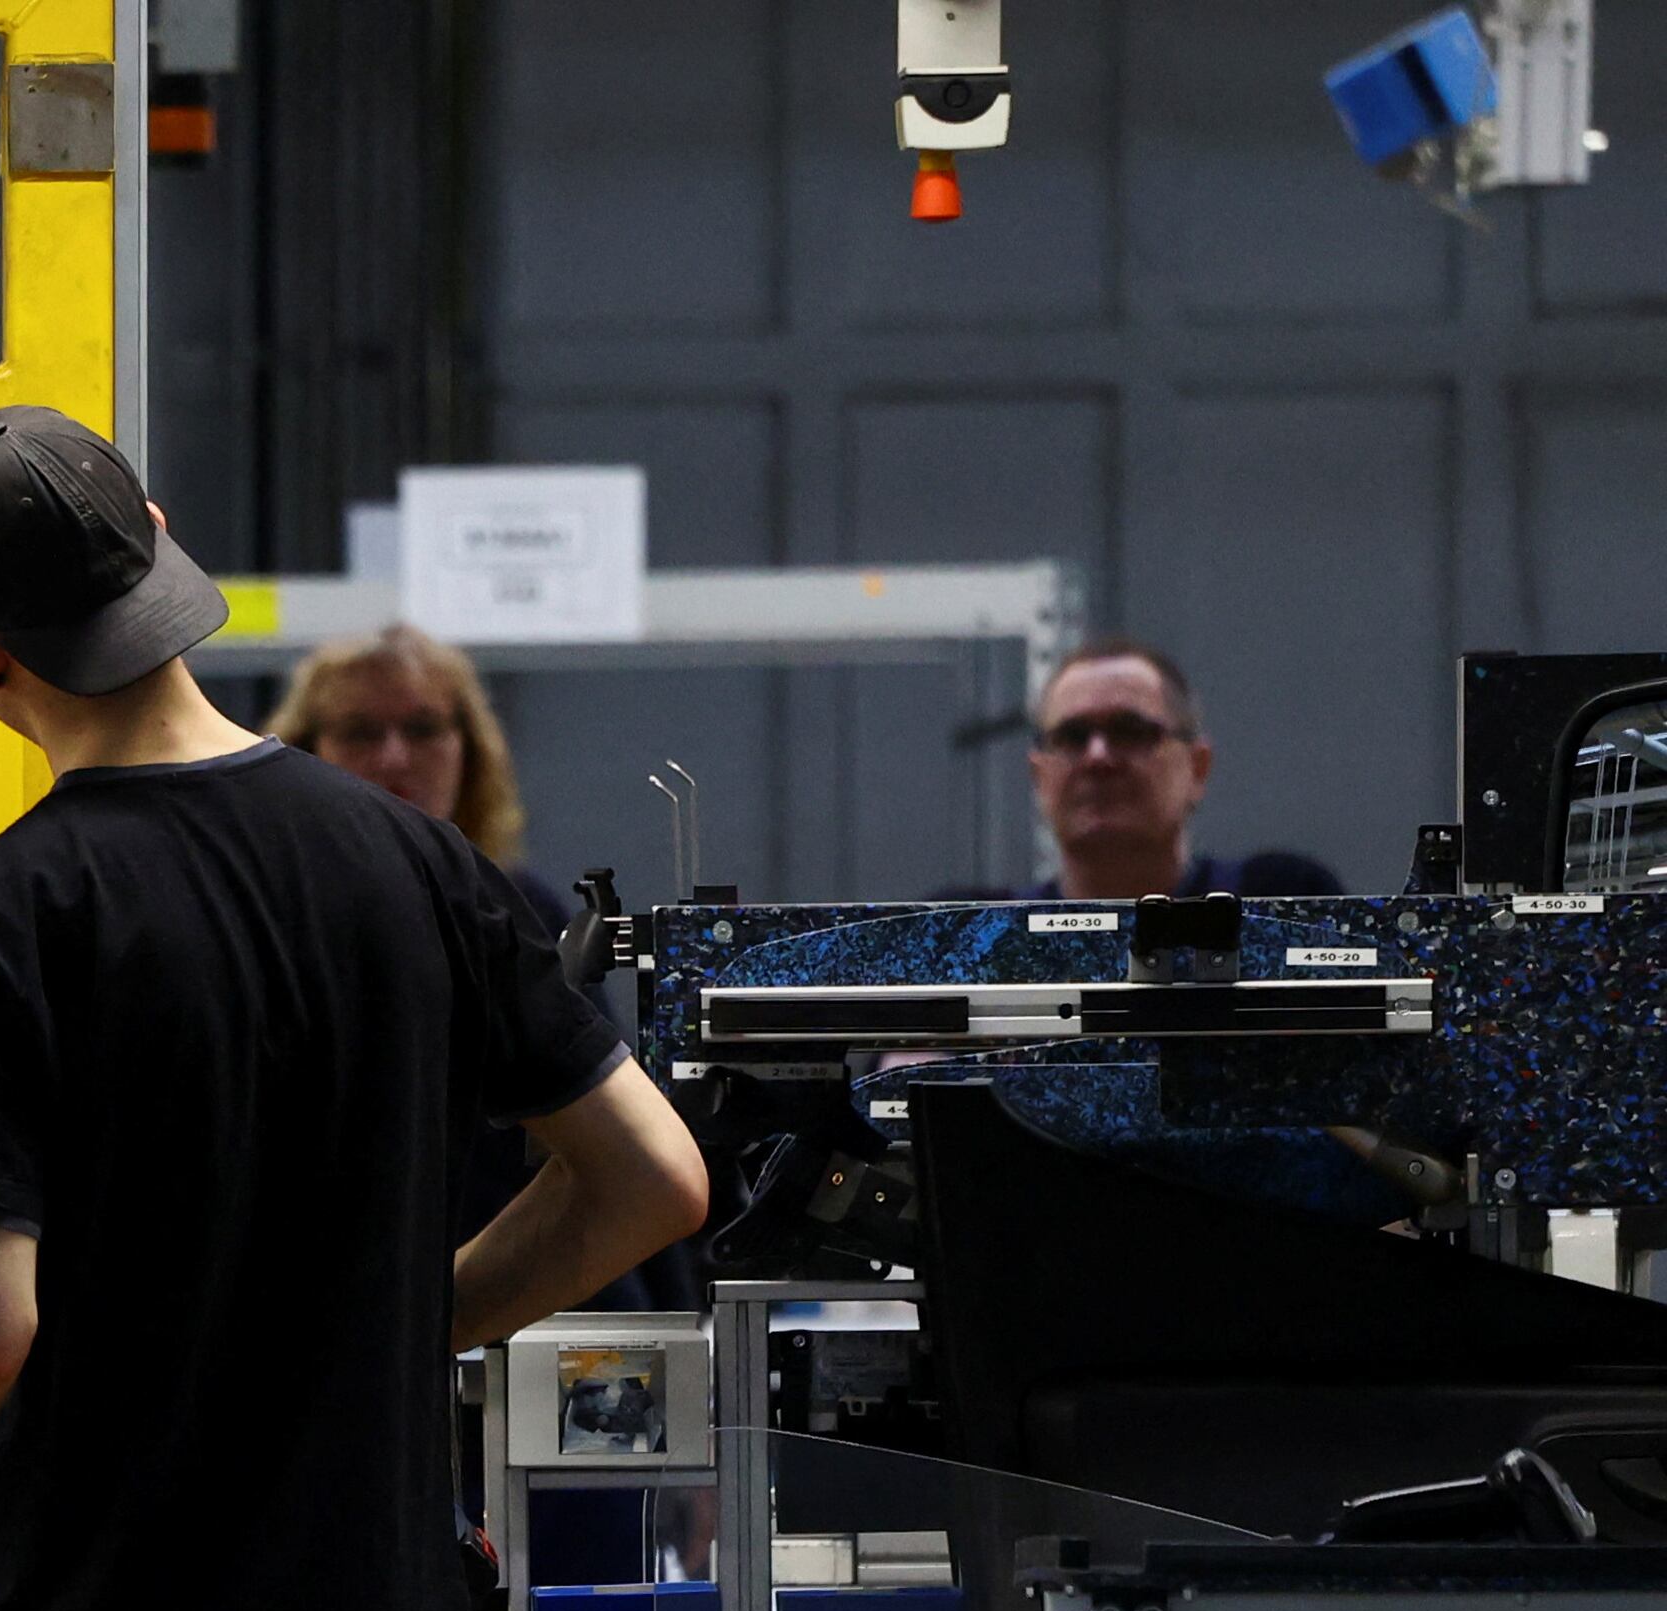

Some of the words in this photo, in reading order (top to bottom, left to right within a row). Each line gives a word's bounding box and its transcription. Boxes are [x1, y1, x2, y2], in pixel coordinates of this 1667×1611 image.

[1530, 900, 1586, 909] 4-50-30
[1046, 918, 1101, 927] 4-40-30
[1304, 953, 1360, 961] 4-50-20
